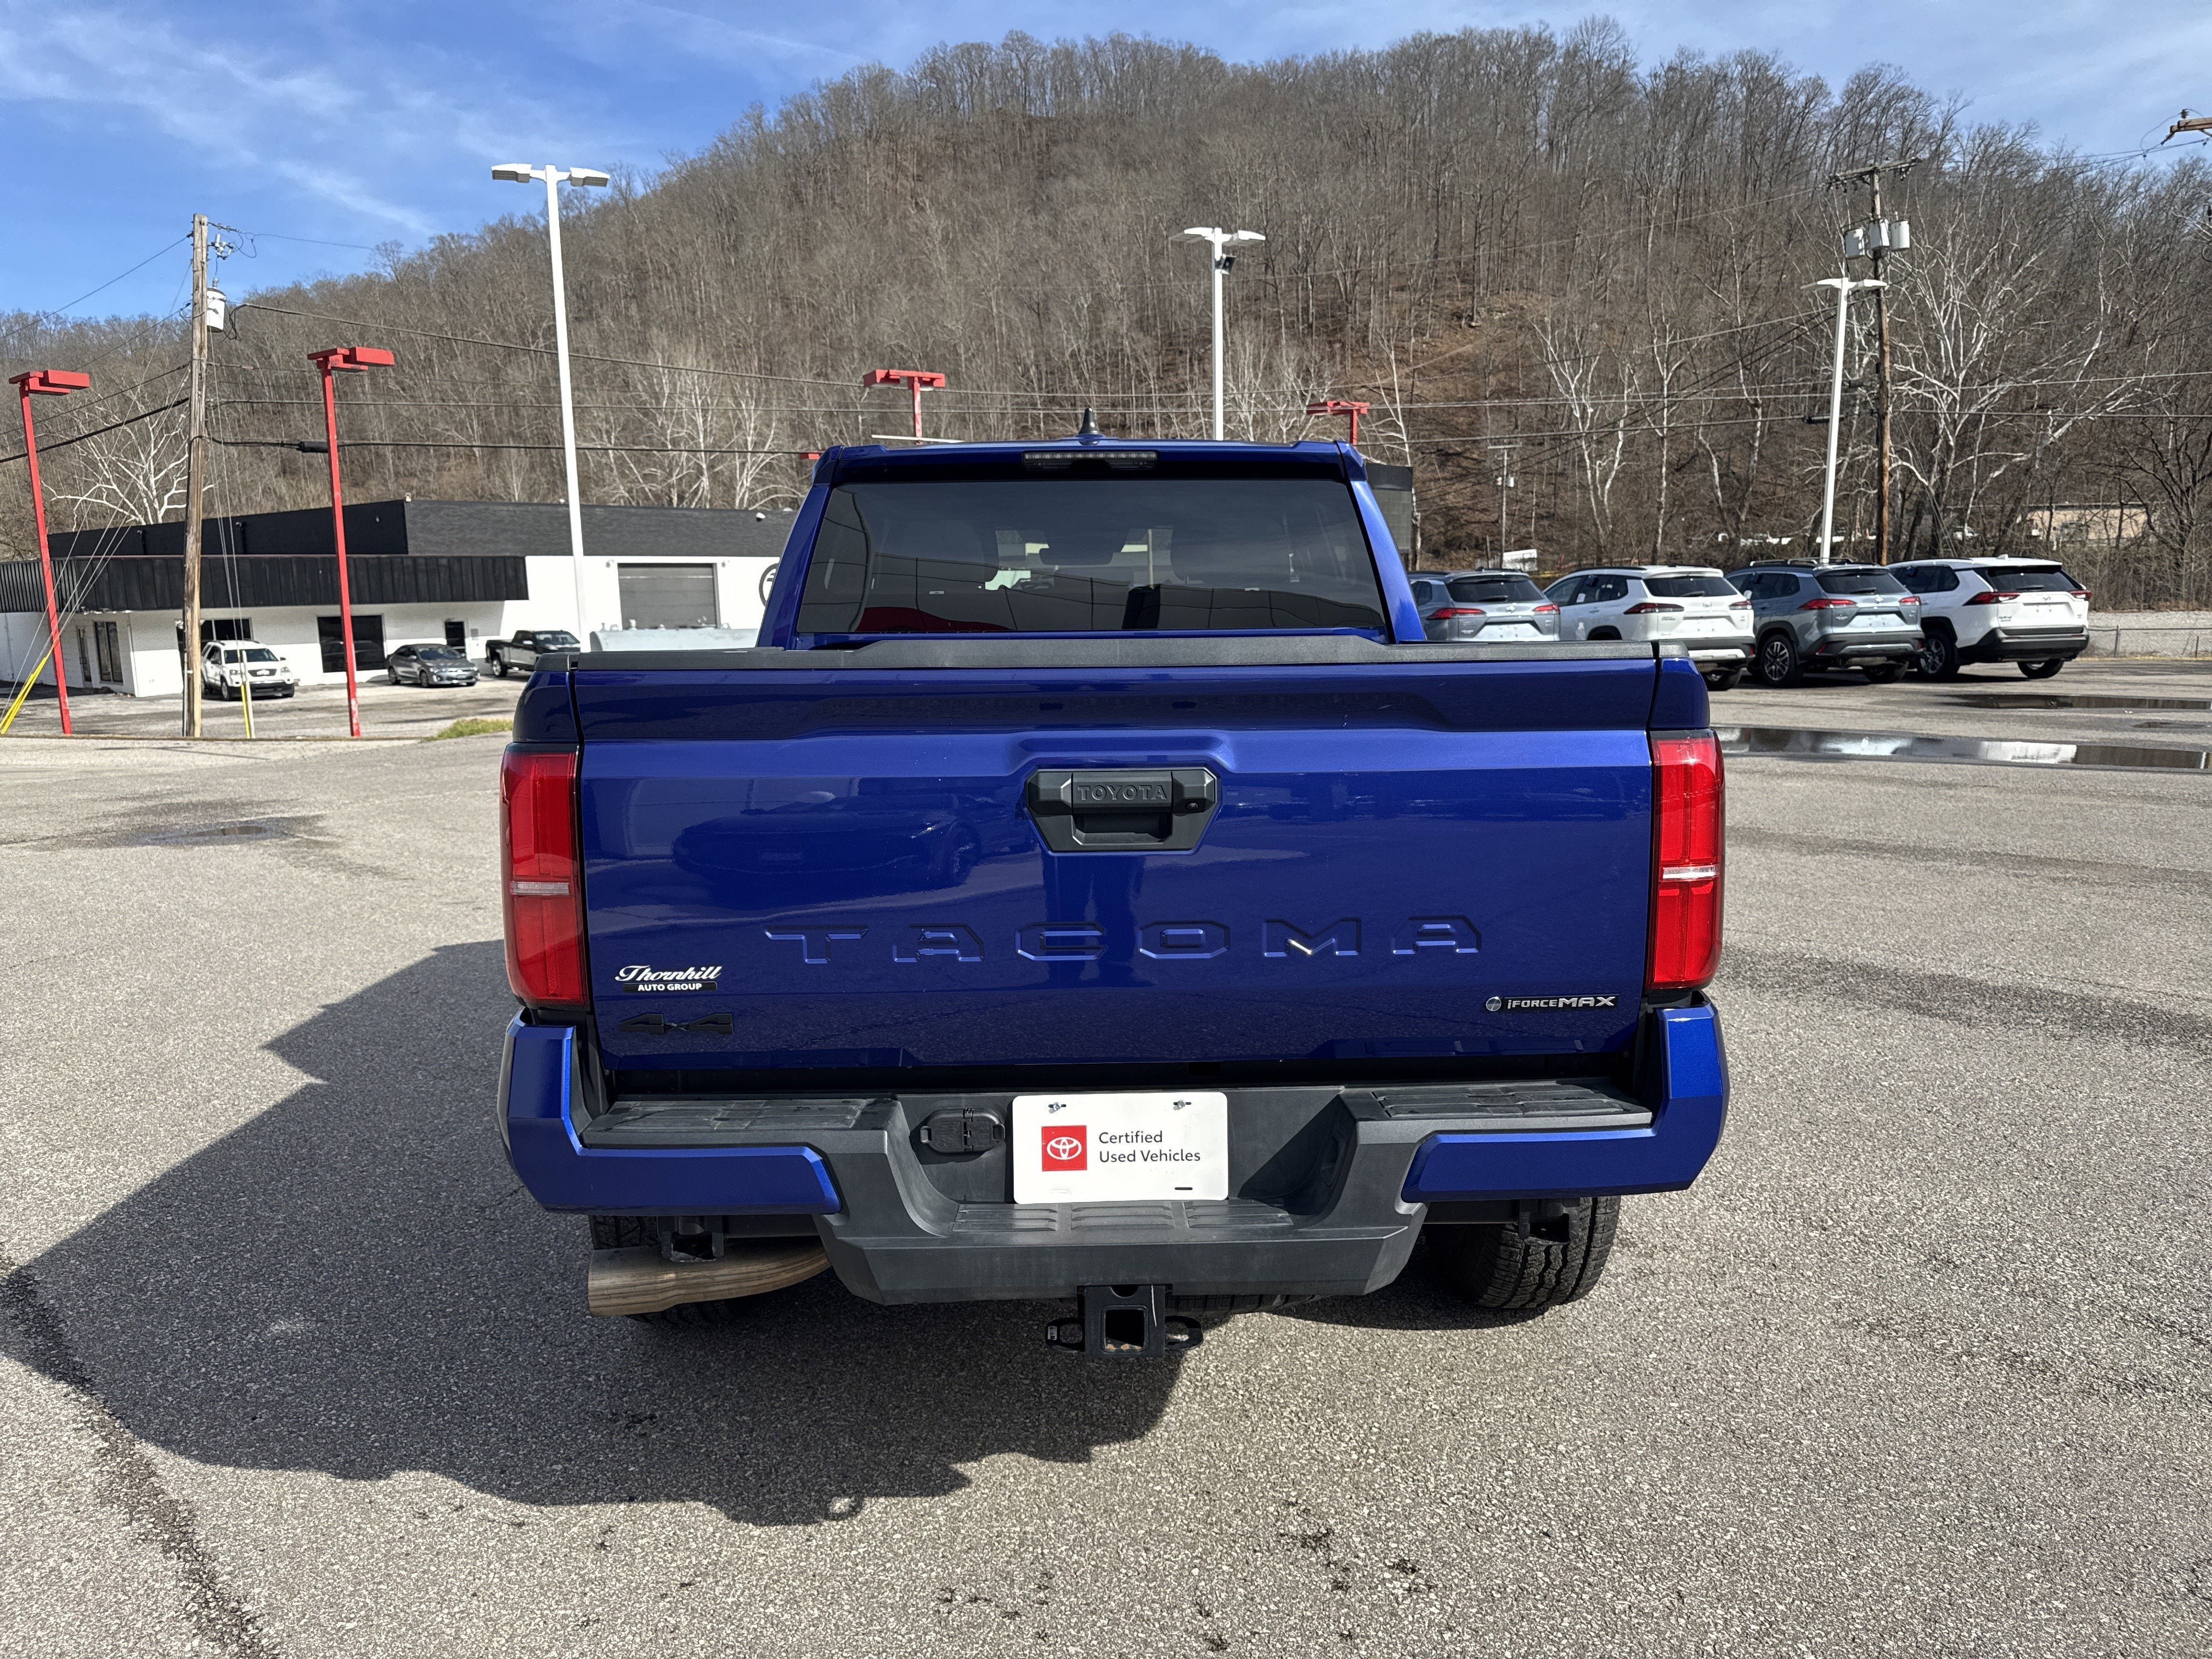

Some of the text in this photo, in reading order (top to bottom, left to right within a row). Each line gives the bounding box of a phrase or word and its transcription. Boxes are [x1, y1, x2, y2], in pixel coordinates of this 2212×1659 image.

[1077, 785, 1167, 801] TOYOTA
[765, 915, 1481, 964] TACOMA
[614, 964, 723, 981] Thornhill
[637, 983, 703, 992] AUTO GROUP
[1098, 1130, 1163, 1144] Certified
[1099, 1149, 1201, 1163] Used Vehicles
